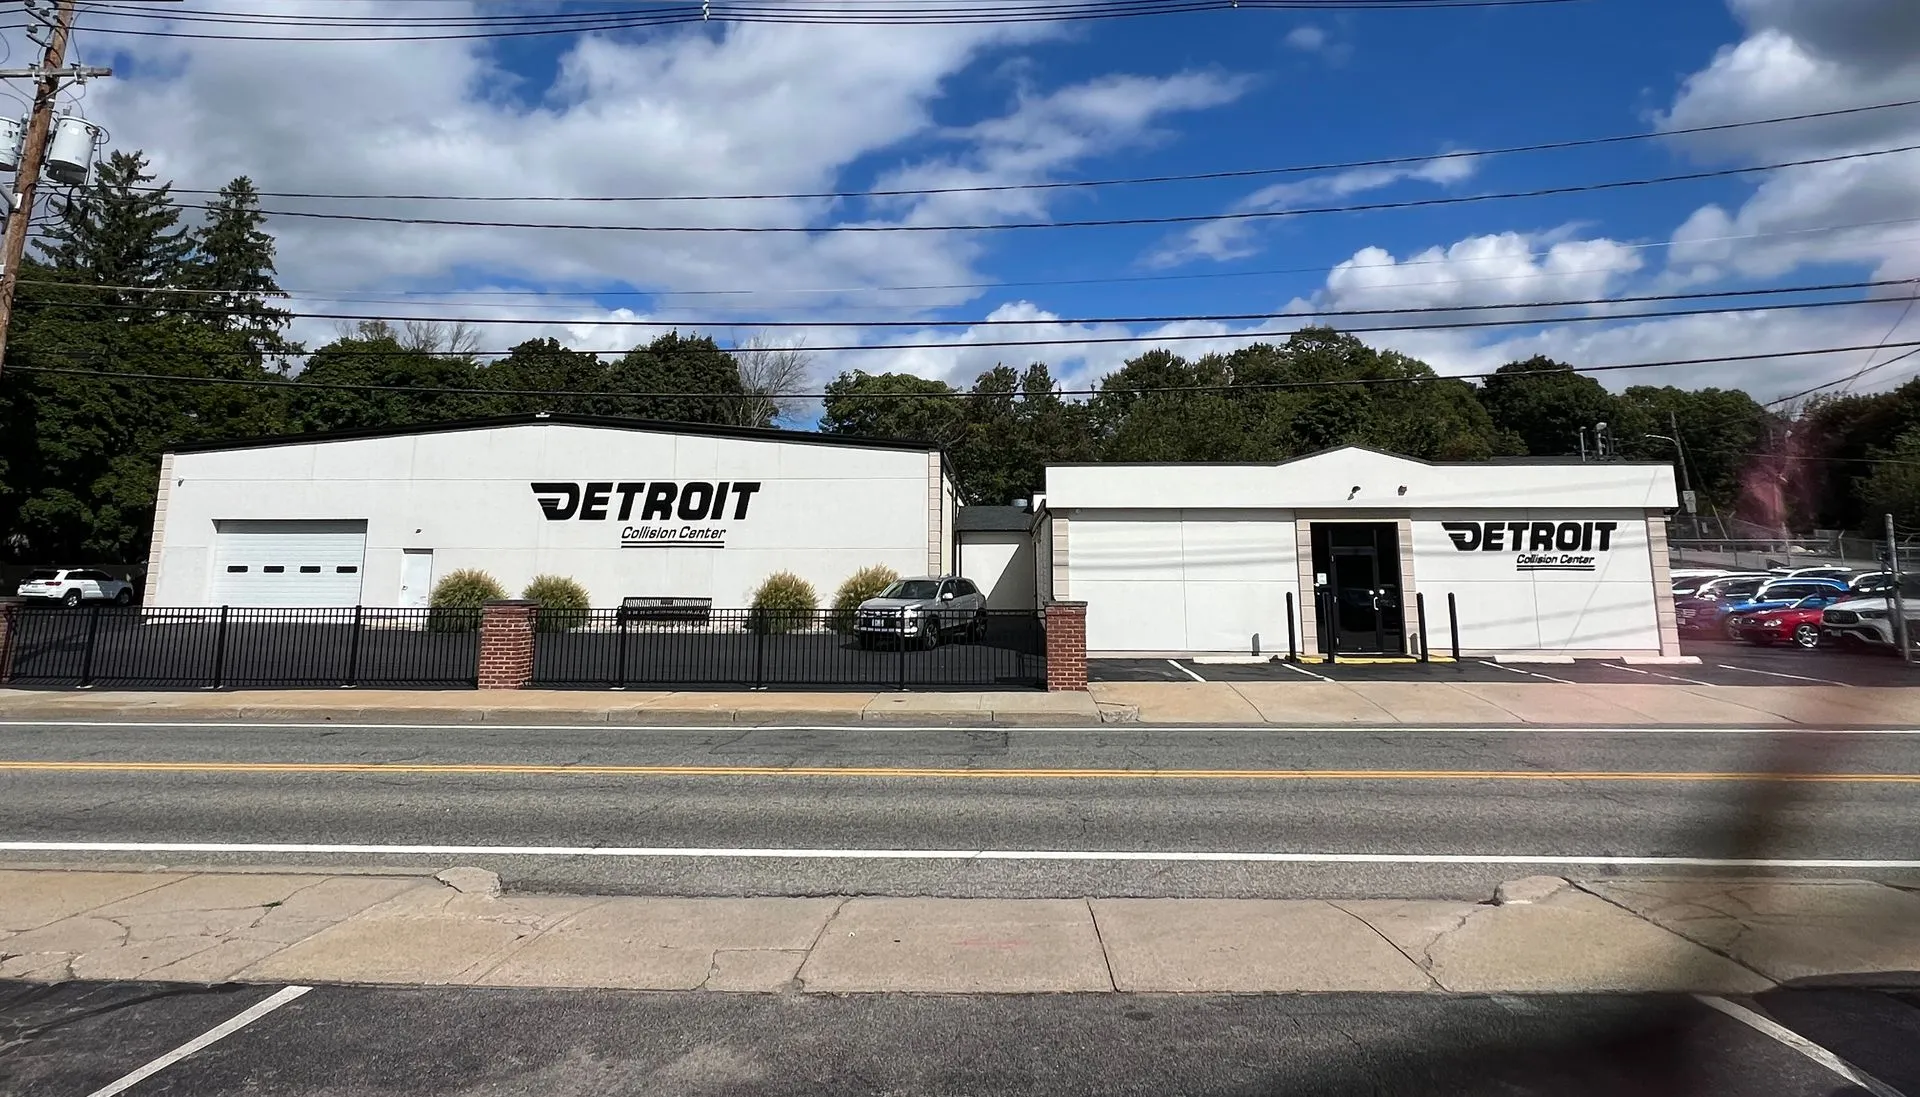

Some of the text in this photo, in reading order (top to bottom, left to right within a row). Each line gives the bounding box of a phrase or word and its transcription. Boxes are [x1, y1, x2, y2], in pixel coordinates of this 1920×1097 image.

[531, 482, 761, 521] DETROIT
[621, 526, 727, 540] Collision Center
[1441, 522, 1617, 552] DETROIT
[1516, 554, 1595, 564] Collision Center
